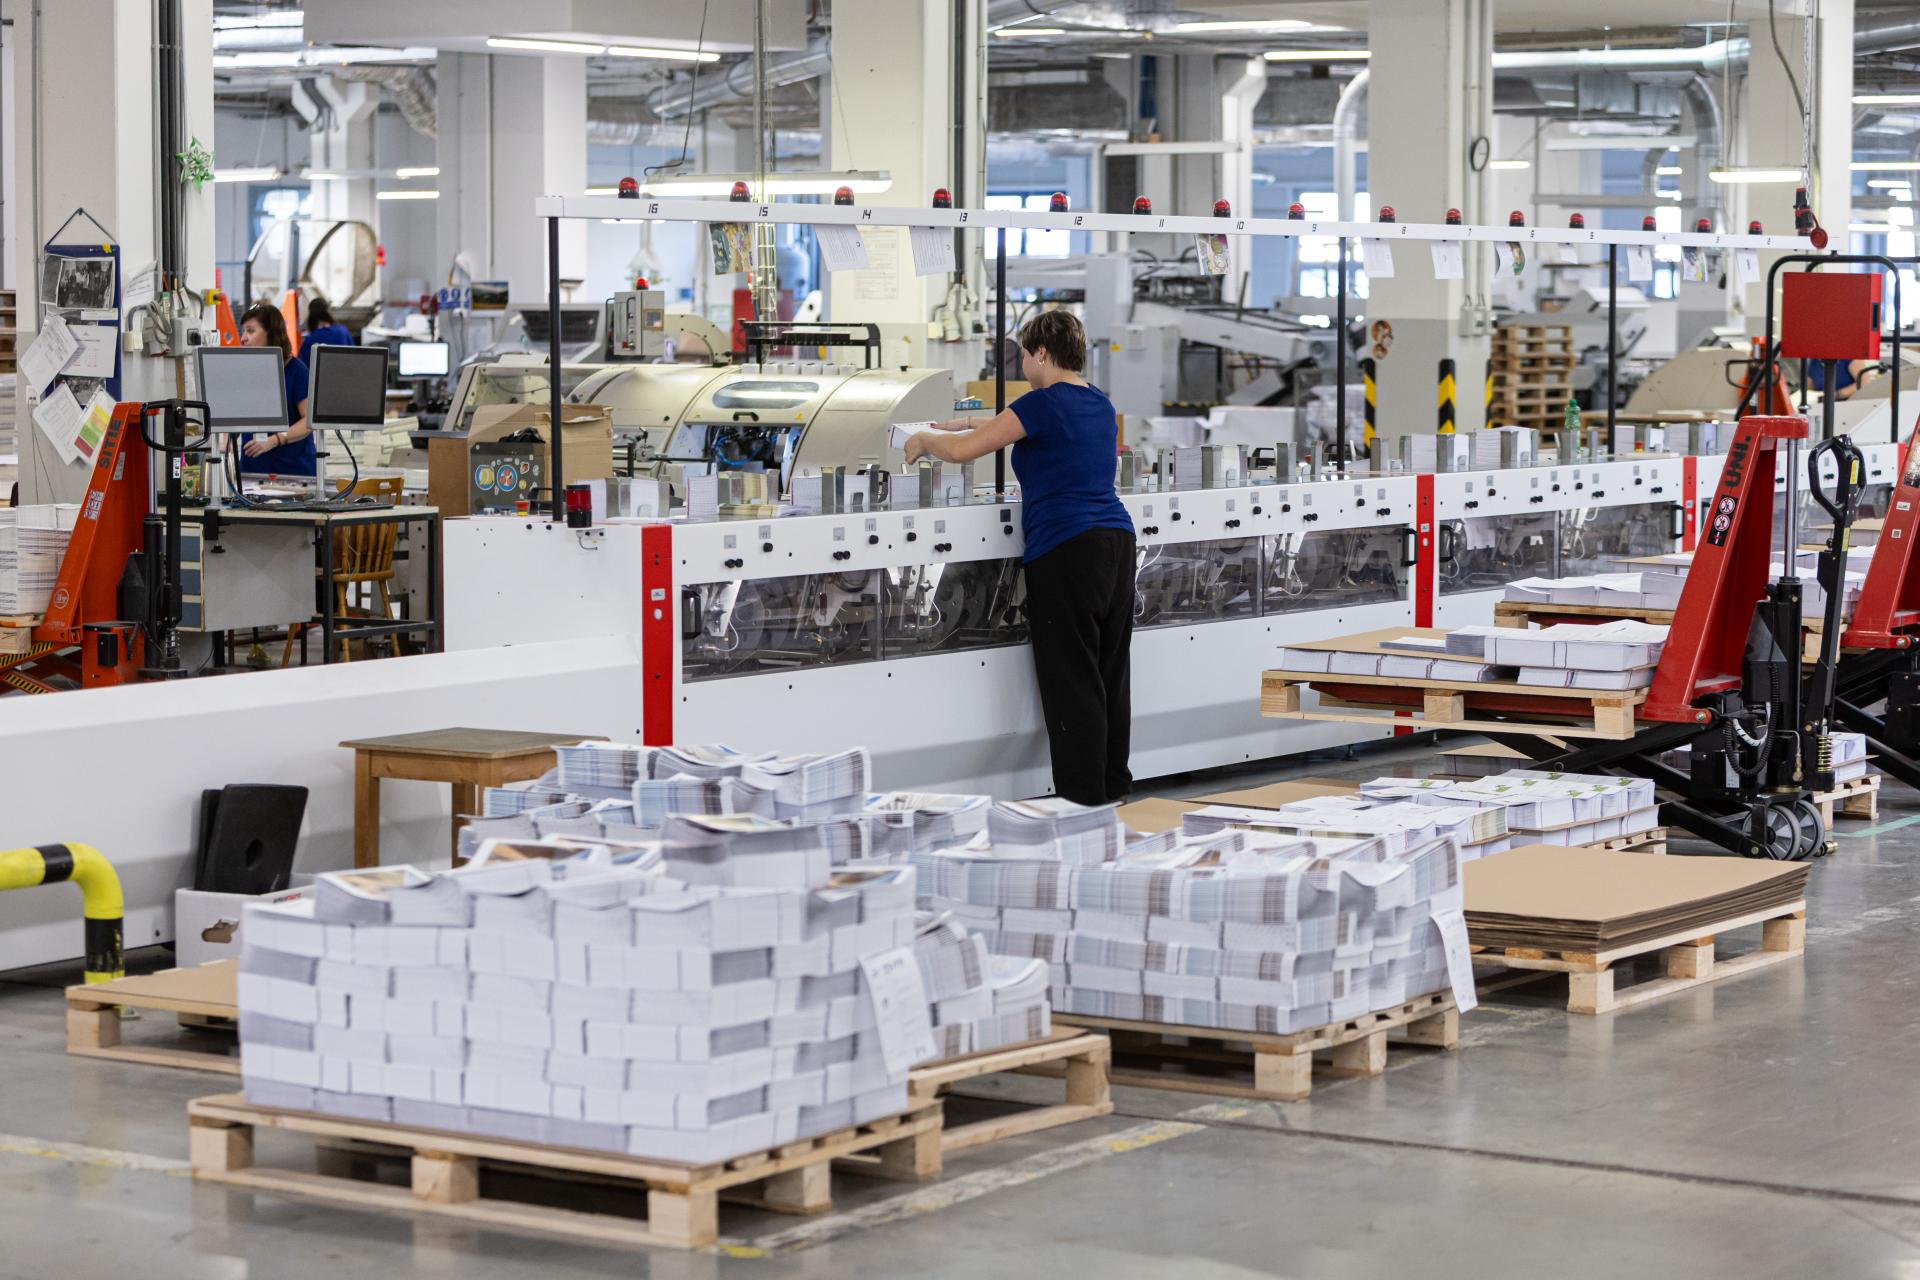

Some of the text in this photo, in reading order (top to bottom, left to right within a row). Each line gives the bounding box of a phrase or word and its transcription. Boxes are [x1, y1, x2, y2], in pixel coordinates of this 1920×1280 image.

[648, 203, 659, 214] 16
[758, 206, 769, 217] 15
[862, 209, 872, 220] 14
[959, 212, 968, 222] 13
[1074, 216, 1083, 226] 12
[1158, 218, 1165, 228] 11
[1236, 221, 1245, 230] 10
[1311, 223, 1317, 232] 9
